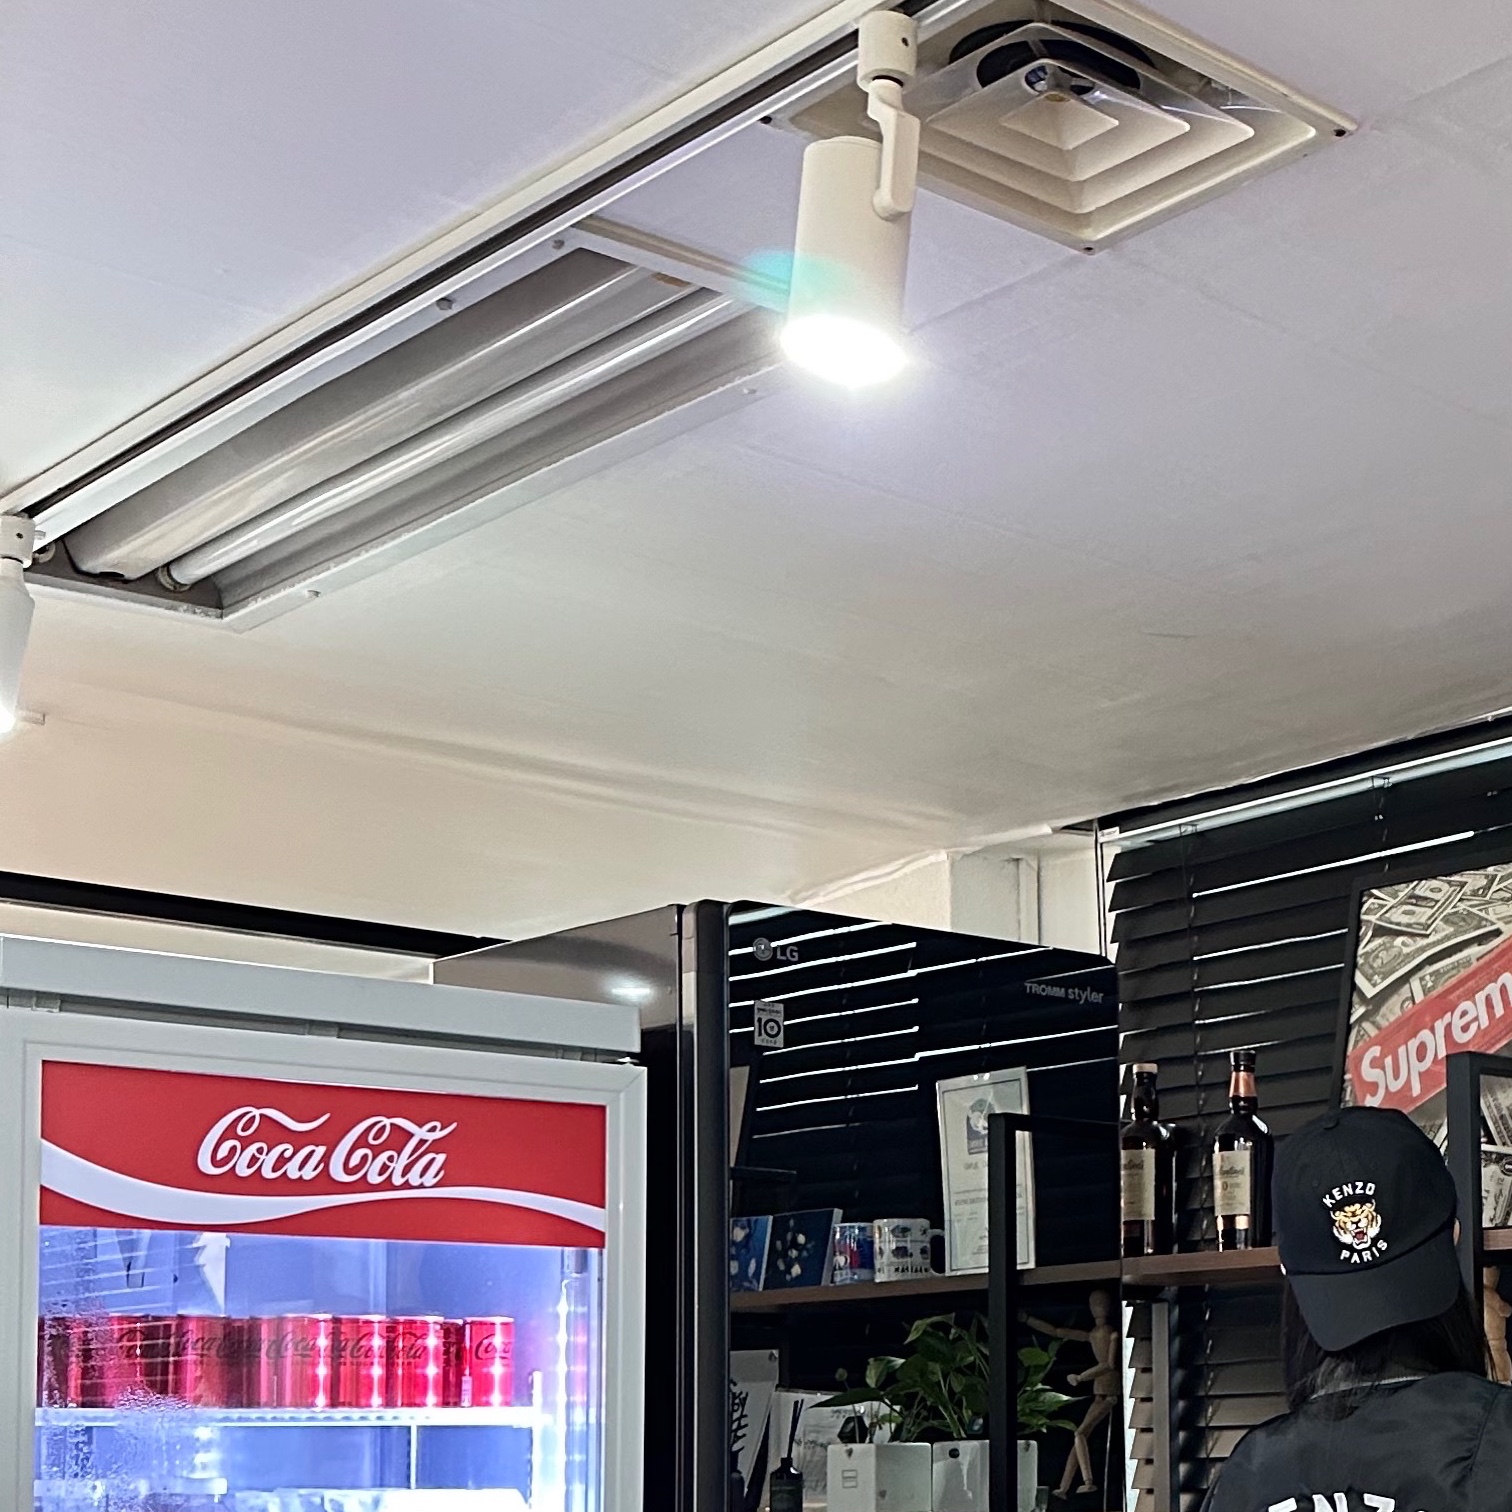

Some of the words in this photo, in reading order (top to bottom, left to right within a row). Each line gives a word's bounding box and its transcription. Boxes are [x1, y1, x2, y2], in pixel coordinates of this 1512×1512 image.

[776, 945, 799, 961] LG
[1024, 981, 1066, 998] TROMM
[1067, 986, 1104, 1004] styler
[197, 1106, 331, 1180] Coca
[328, 1116, 458, 1187] Cola
[1322, 1181, 1376, 1209] KENZO
[1339, 1239, 1388, 1264] PARIS
